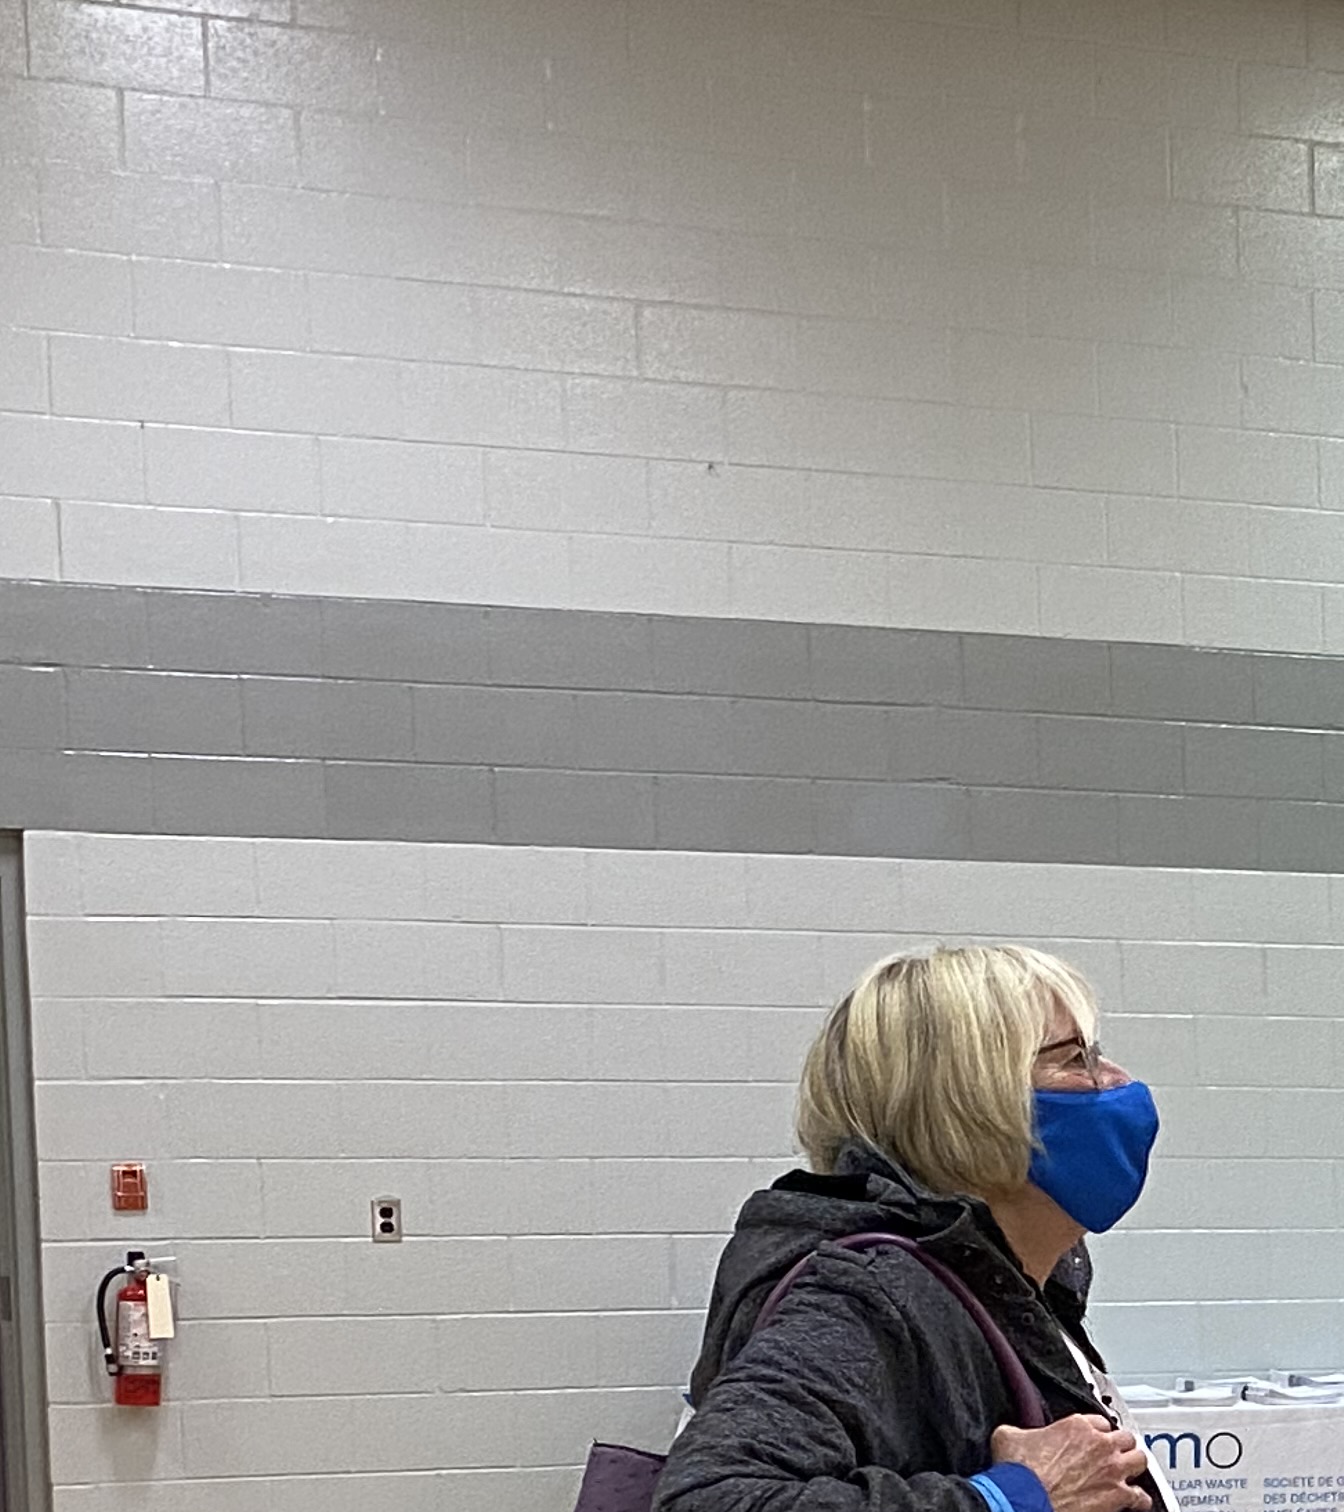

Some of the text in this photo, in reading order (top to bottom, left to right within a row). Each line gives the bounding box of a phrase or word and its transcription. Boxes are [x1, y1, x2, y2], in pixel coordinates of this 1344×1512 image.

[1205, 1477, 1248, 1490] WASTE
[1317, 1475, 1334, 1488] DE
[1263, 1493, 1287, 1505] DES
